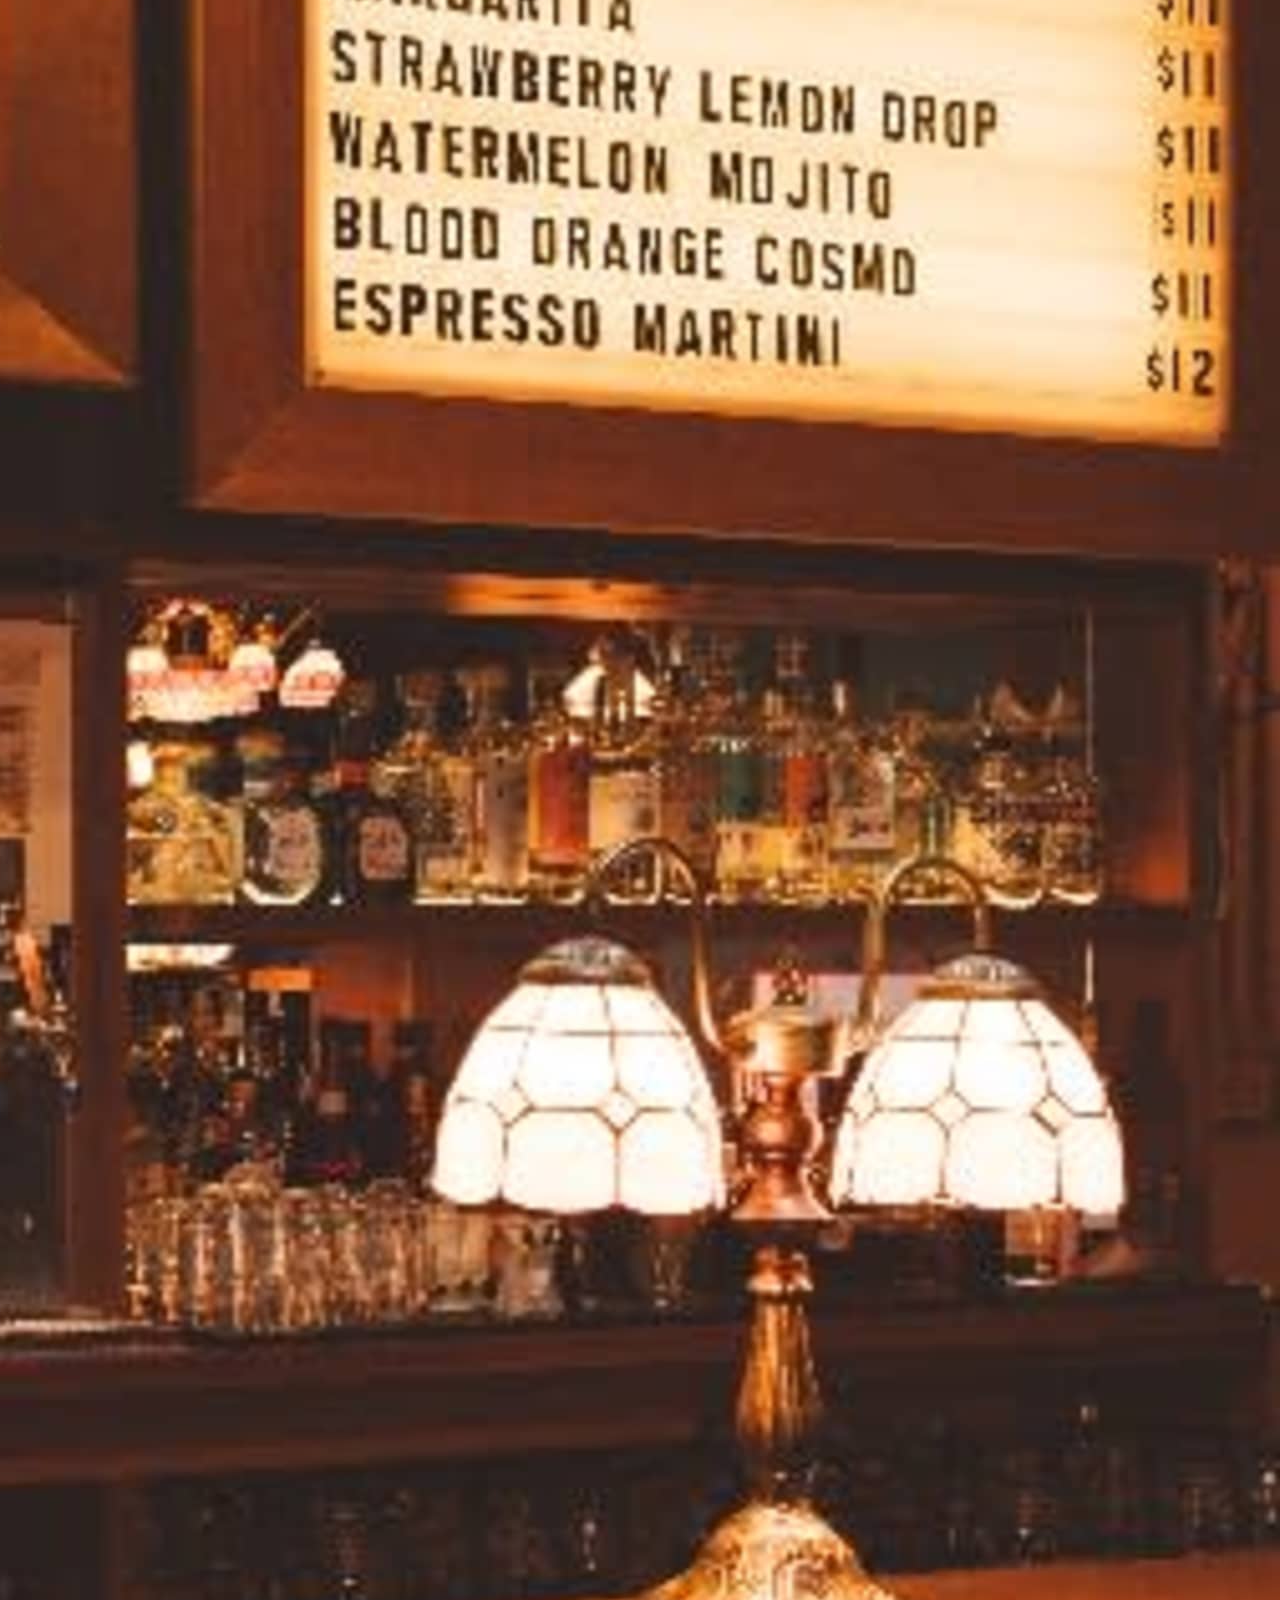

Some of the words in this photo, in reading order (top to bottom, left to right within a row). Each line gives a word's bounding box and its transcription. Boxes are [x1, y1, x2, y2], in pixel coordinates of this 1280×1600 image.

[330, 29, 672, 118] STRAWBERRY
[699, 70, 855, 135] LEMON
[882, 90, 998, 149] DROP
[1155, 125, 1221, 175] $11
[1156, 45, 1215, 99] $11
[328, 110, 668, 195] WATERMELON
[709, 151, 891, 220] MOJITO
[1160, 196, 1216, 247] $11
[333, 196, 500, 261] BLOOD
[531, 216, 725, 281] ORANGE
[755, 233, 916, 297] COSMO
[1150, 271, 1212, 321] $11
[333, 277, 601, 351] ESPRESSO
[633, 303, 841, 367] MARTINI
[1146, 347, 1215, 398] $12
